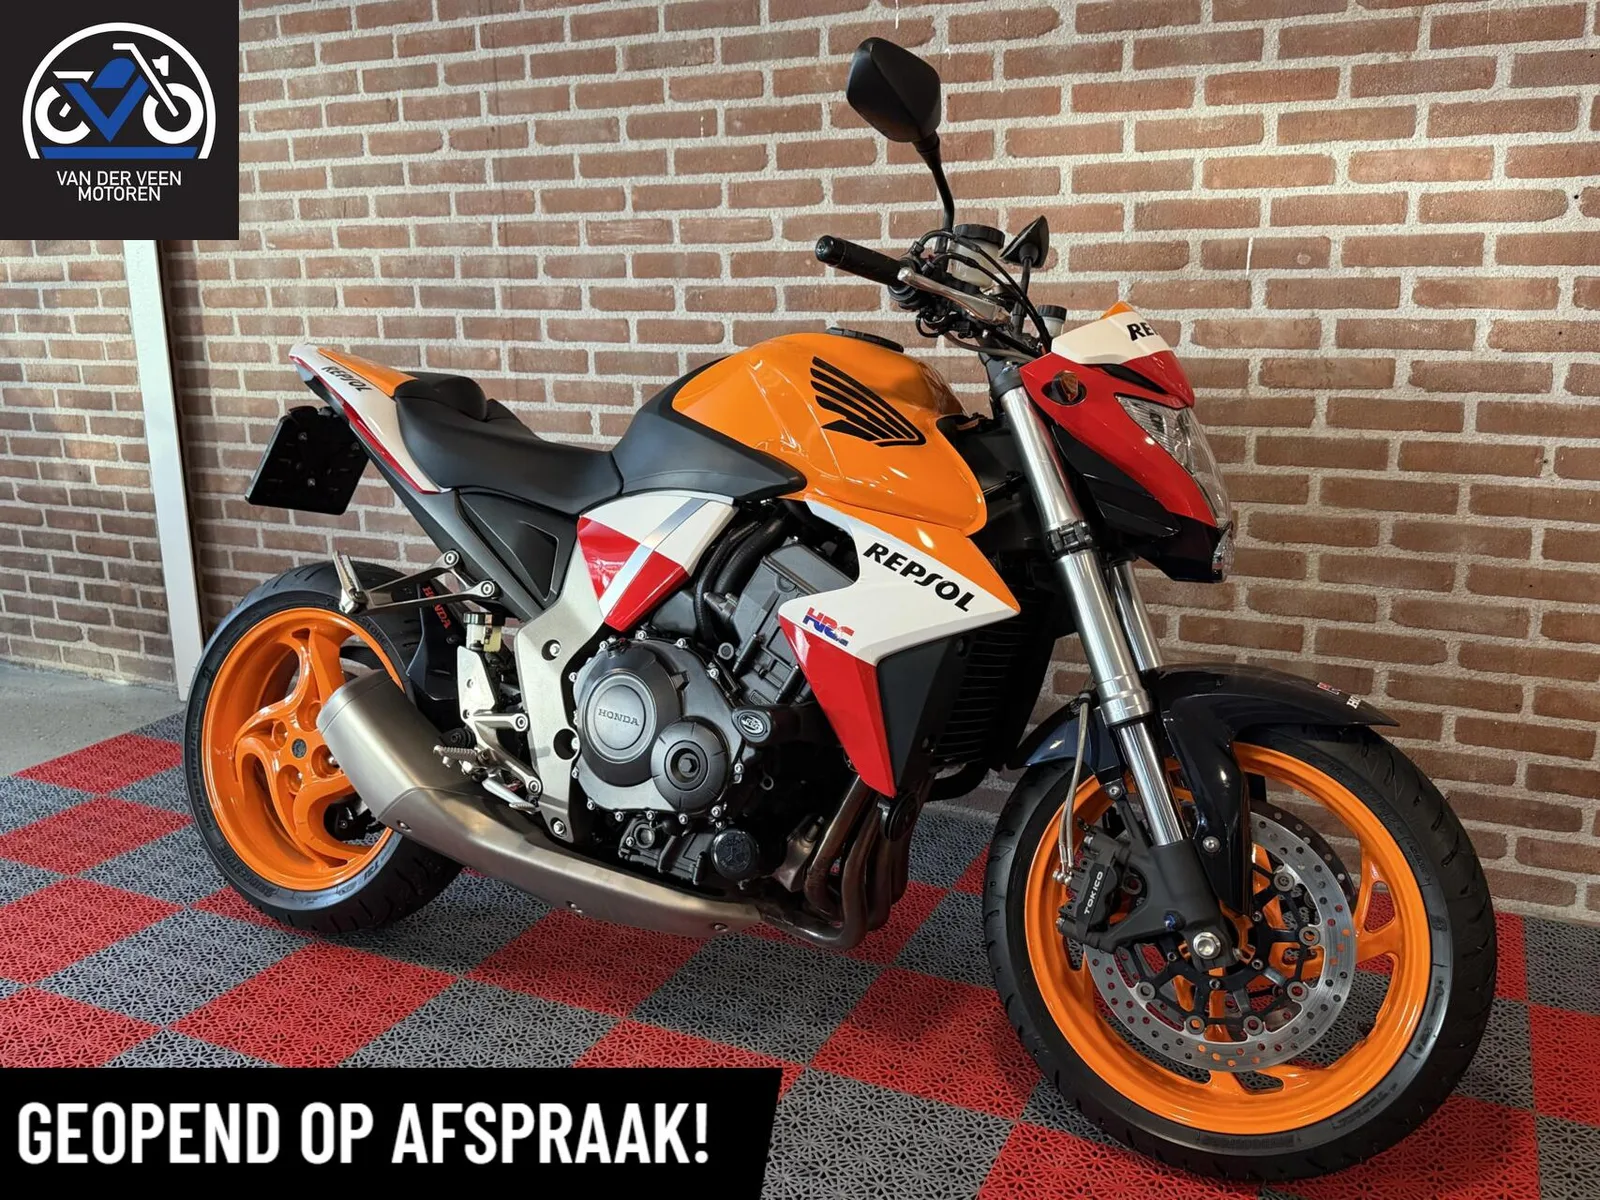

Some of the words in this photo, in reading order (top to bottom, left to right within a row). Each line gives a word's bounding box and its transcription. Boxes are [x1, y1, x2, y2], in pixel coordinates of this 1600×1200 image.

[321, 365, 373, 392] REPSOL
[862, 542, 976, 612] REPSOL
[803, 607, 854, 646] HRC
[598, 708, 640, 727] HONDA
[1084, 871, 1104, 915] TOKICO
